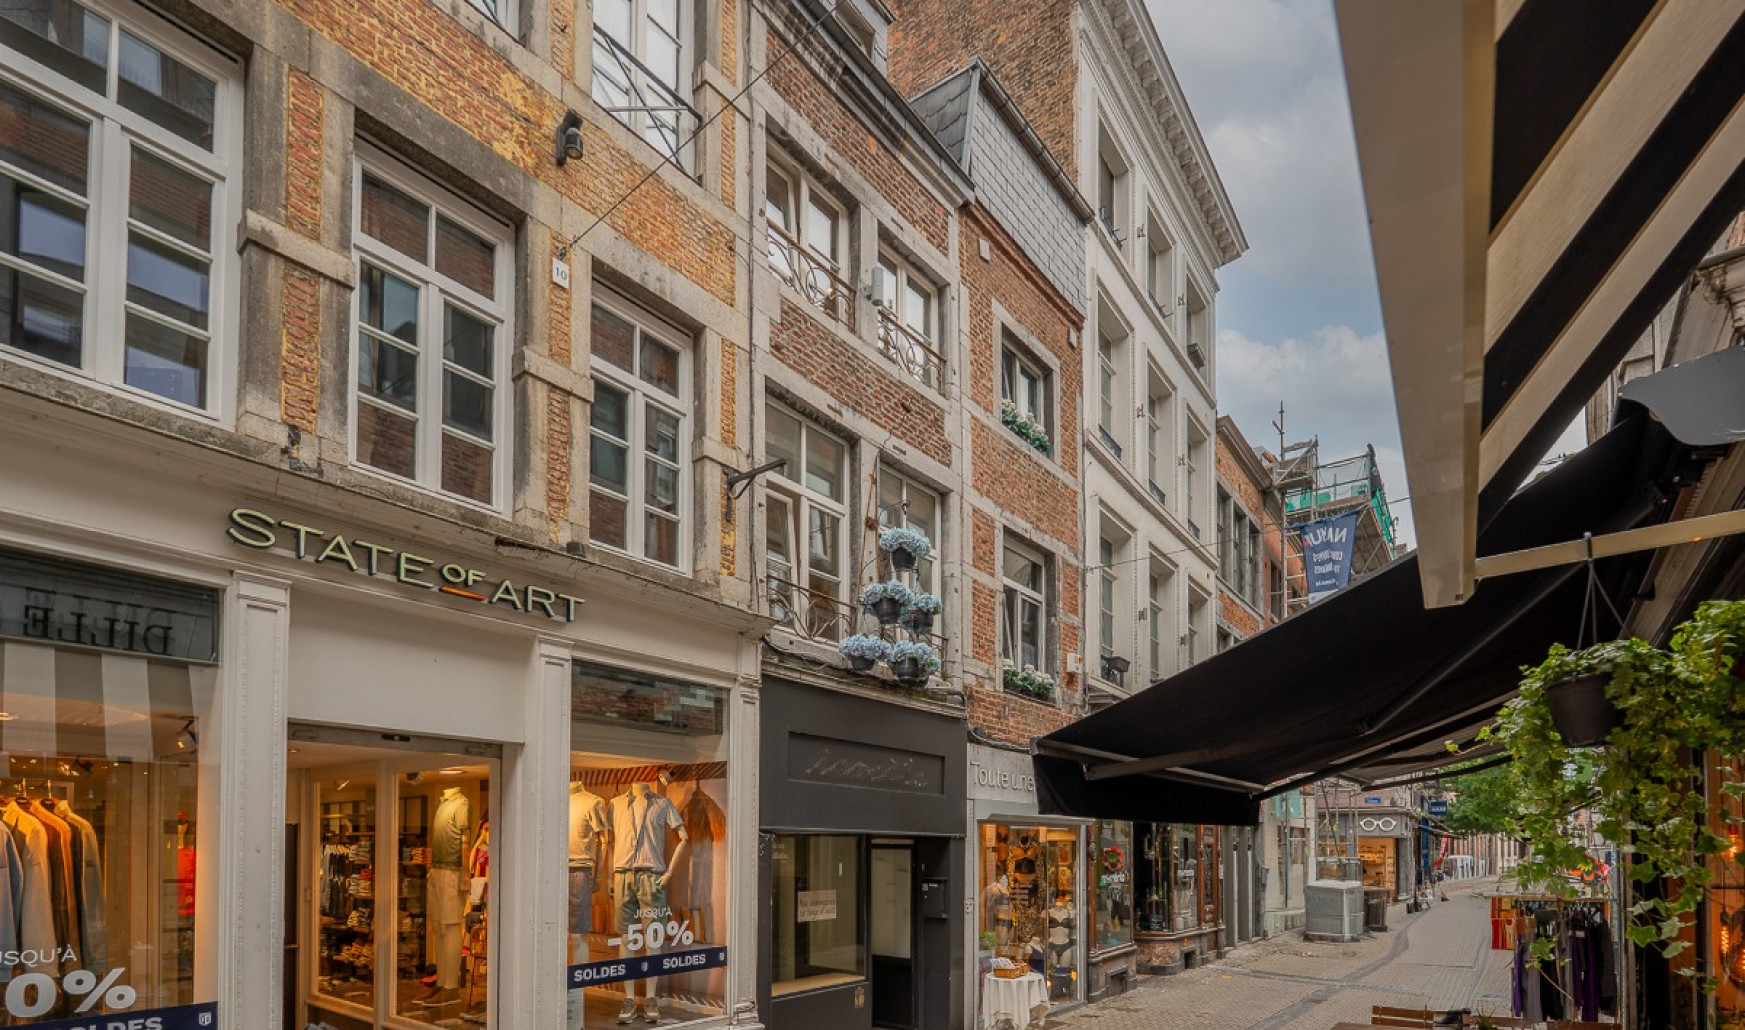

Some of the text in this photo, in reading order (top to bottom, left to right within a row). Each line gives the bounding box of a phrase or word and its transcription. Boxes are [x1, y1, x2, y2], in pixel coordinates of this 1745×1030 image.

[556, 267, 568, 280] 10
[226, 507, 586, 622] STATE OF ART
[969, 760, 1035, 792] Toute une
[607, 920, 694, 950] -50%
[0, 943, 78, 967] SQU'À
[574, 964, 627, 982] SOLDES
[662, 953, 706, 970] SOLDES
